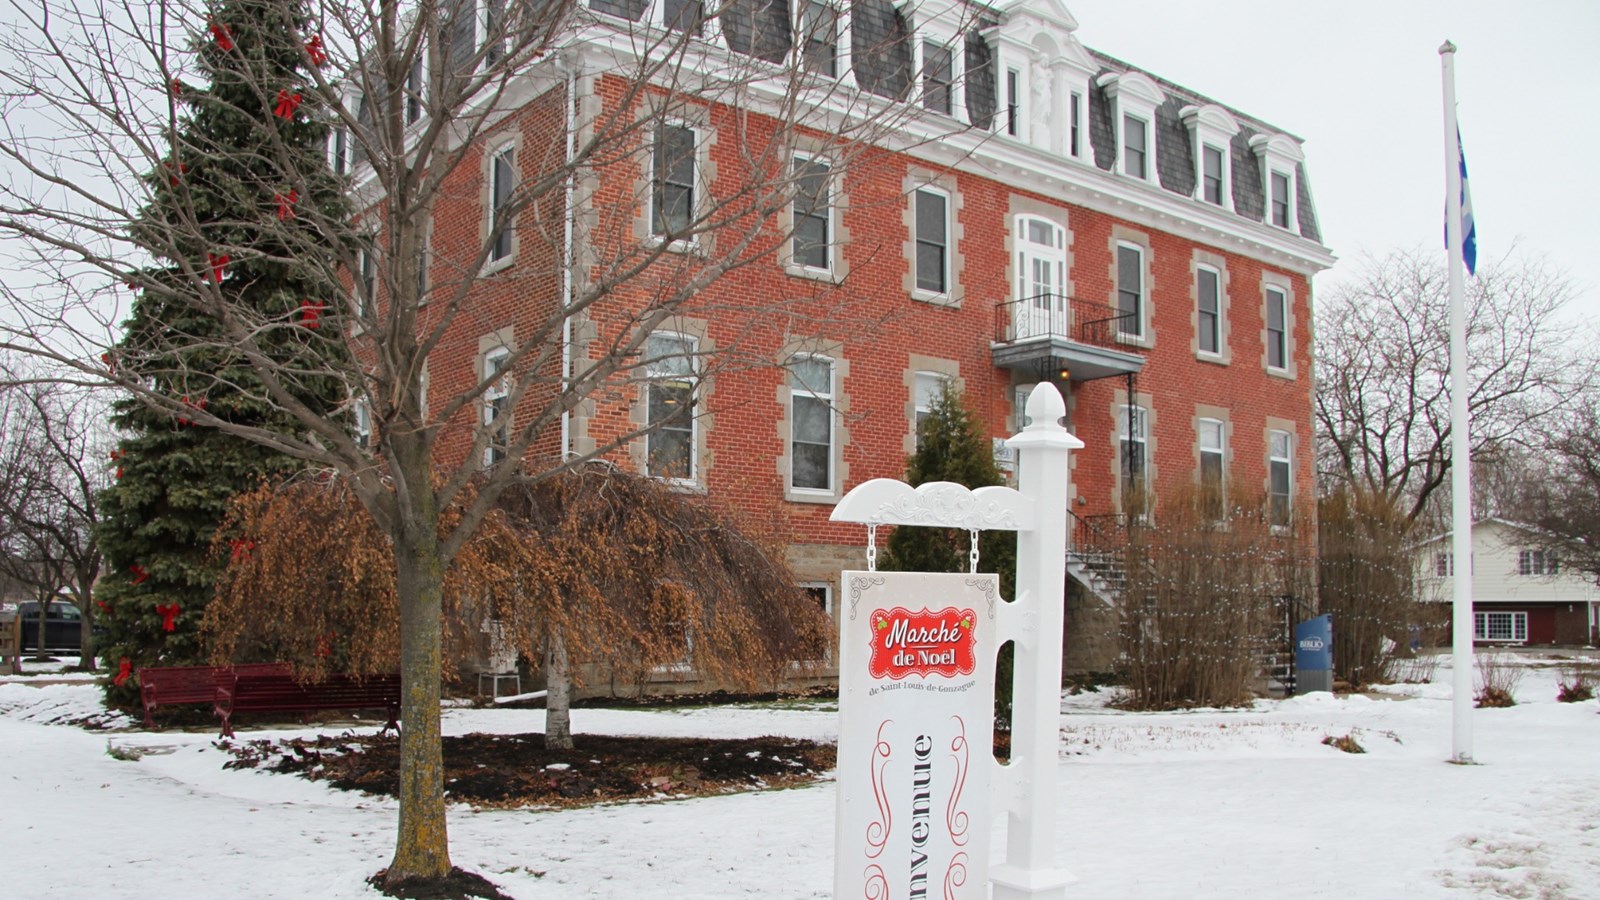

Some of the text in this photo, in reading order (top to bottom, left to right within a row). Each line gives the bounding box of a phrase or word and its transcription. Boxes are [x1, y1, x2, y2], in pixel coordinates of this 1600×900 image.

[885, 618, 963, 649] Marché
[1299, 640, 1324, 649] BIBLIO
[892, 648, 956, 667] de Noël
[869, 687, 880, 696] de
